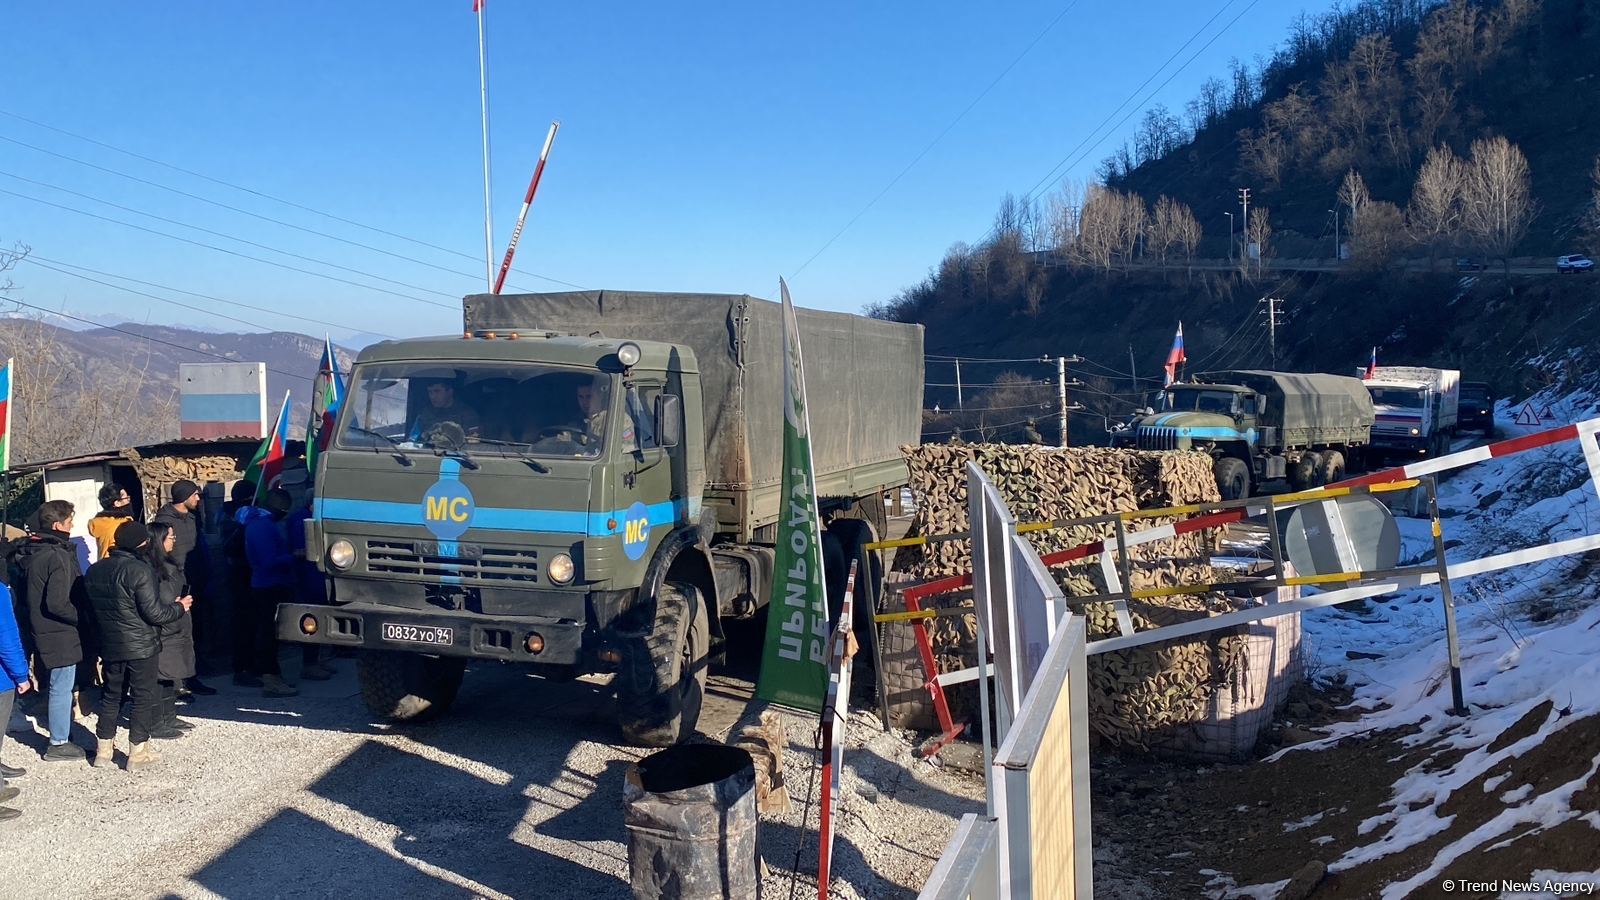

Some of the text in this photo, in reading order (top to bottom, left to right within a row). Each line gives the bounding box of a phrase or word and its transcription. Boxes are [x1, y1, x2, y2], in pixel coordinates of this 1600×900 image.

[426, 495, 469, 522] МС
[625, 517, 648, 545] МС
[387, 625, 418, 641] 0832
[436, 629, 449, 640] 94
